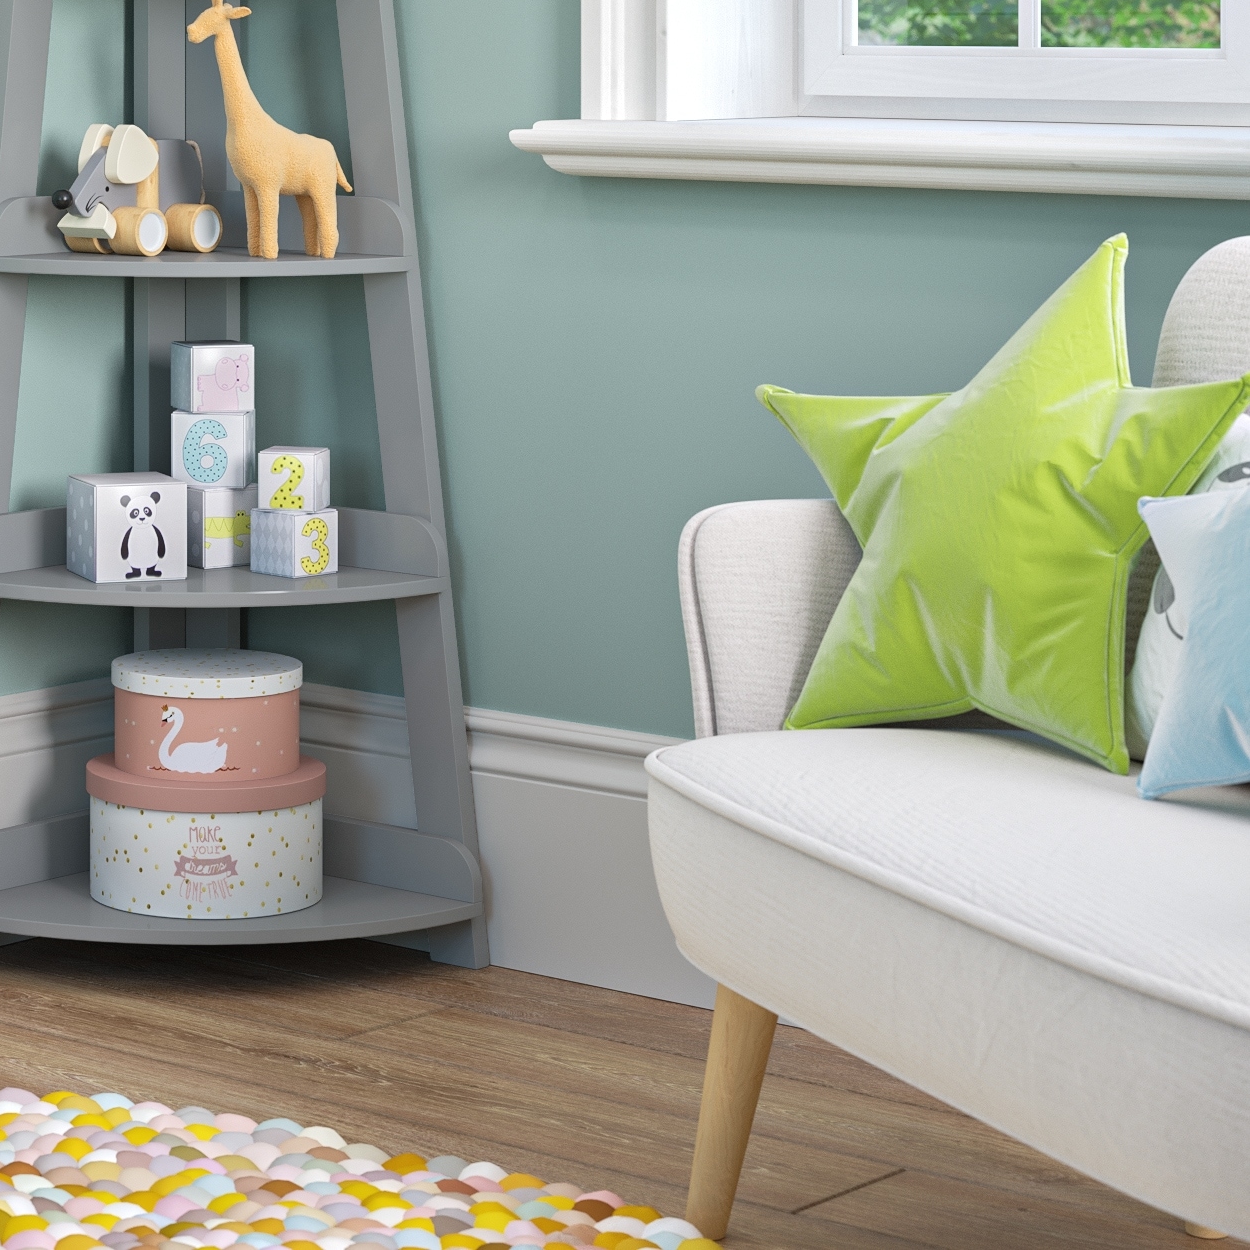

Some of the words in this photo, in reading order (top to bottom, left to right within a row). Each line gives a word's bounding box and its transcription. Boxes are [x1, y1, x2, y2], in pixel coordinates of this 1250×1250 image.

[182, 418, 228, 483] 6
[269, 454, 305, 510] 2
[300, 517, 330, 575] 3
[184, 860, 227, 875] dreams
[191, 845, 222, 857] your
